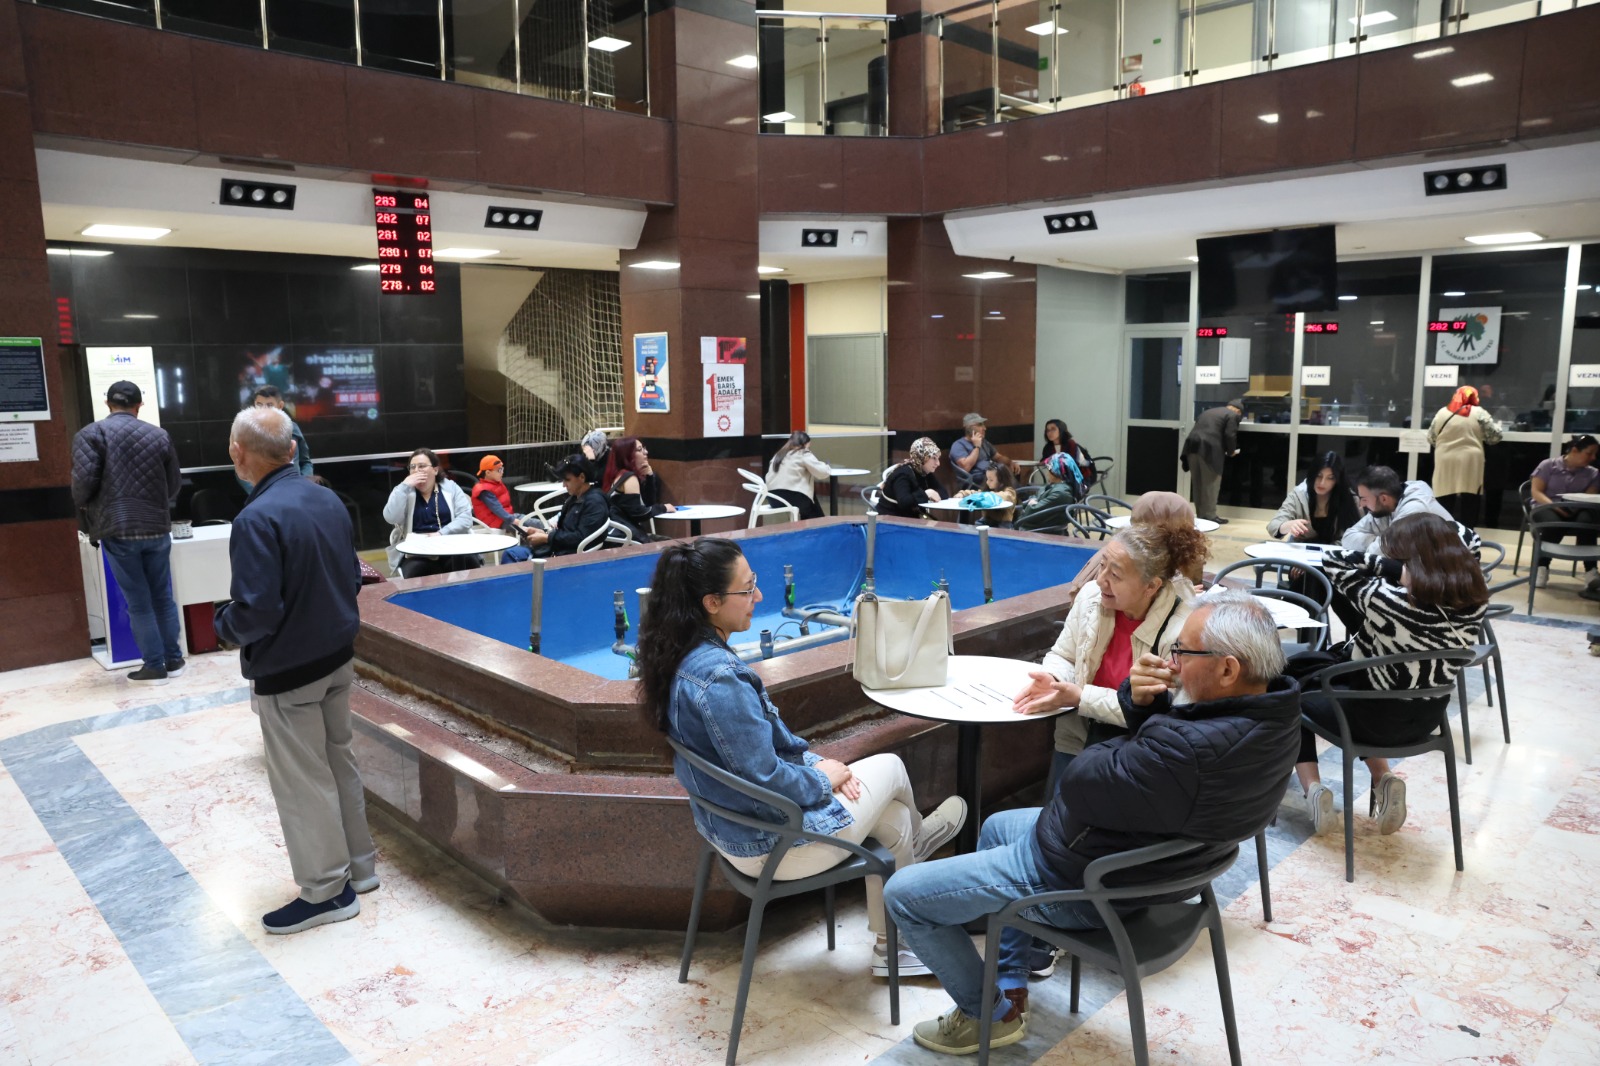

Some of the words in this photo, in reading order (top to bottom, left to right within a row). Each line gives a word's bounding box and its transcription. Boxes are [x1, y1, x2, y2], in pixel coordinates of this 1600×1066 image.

[375, 196, 396, 207] 283
[414, 198, 428, 209] 04
[376, 213, 398, 224] 282
[416, 215, 429, 225] 07
[377, 230, 398, 240] 281
[417, 231, 431, 242] 02
[379, 247, 400, 257] 280
[418, 248, 432, 258] 07
[380, 264, 402, 274] 279
[419, 264, 433, 275] 04
[381, 280, 403, 291] 278
[421, 281, 435, 291] 02
[1326, 323, 1338, 331] 06
[1429, 322, 1448, 331] 282
[1452, 321, 1467, 330] 07
[717, 388, 742, 396] ADALET
